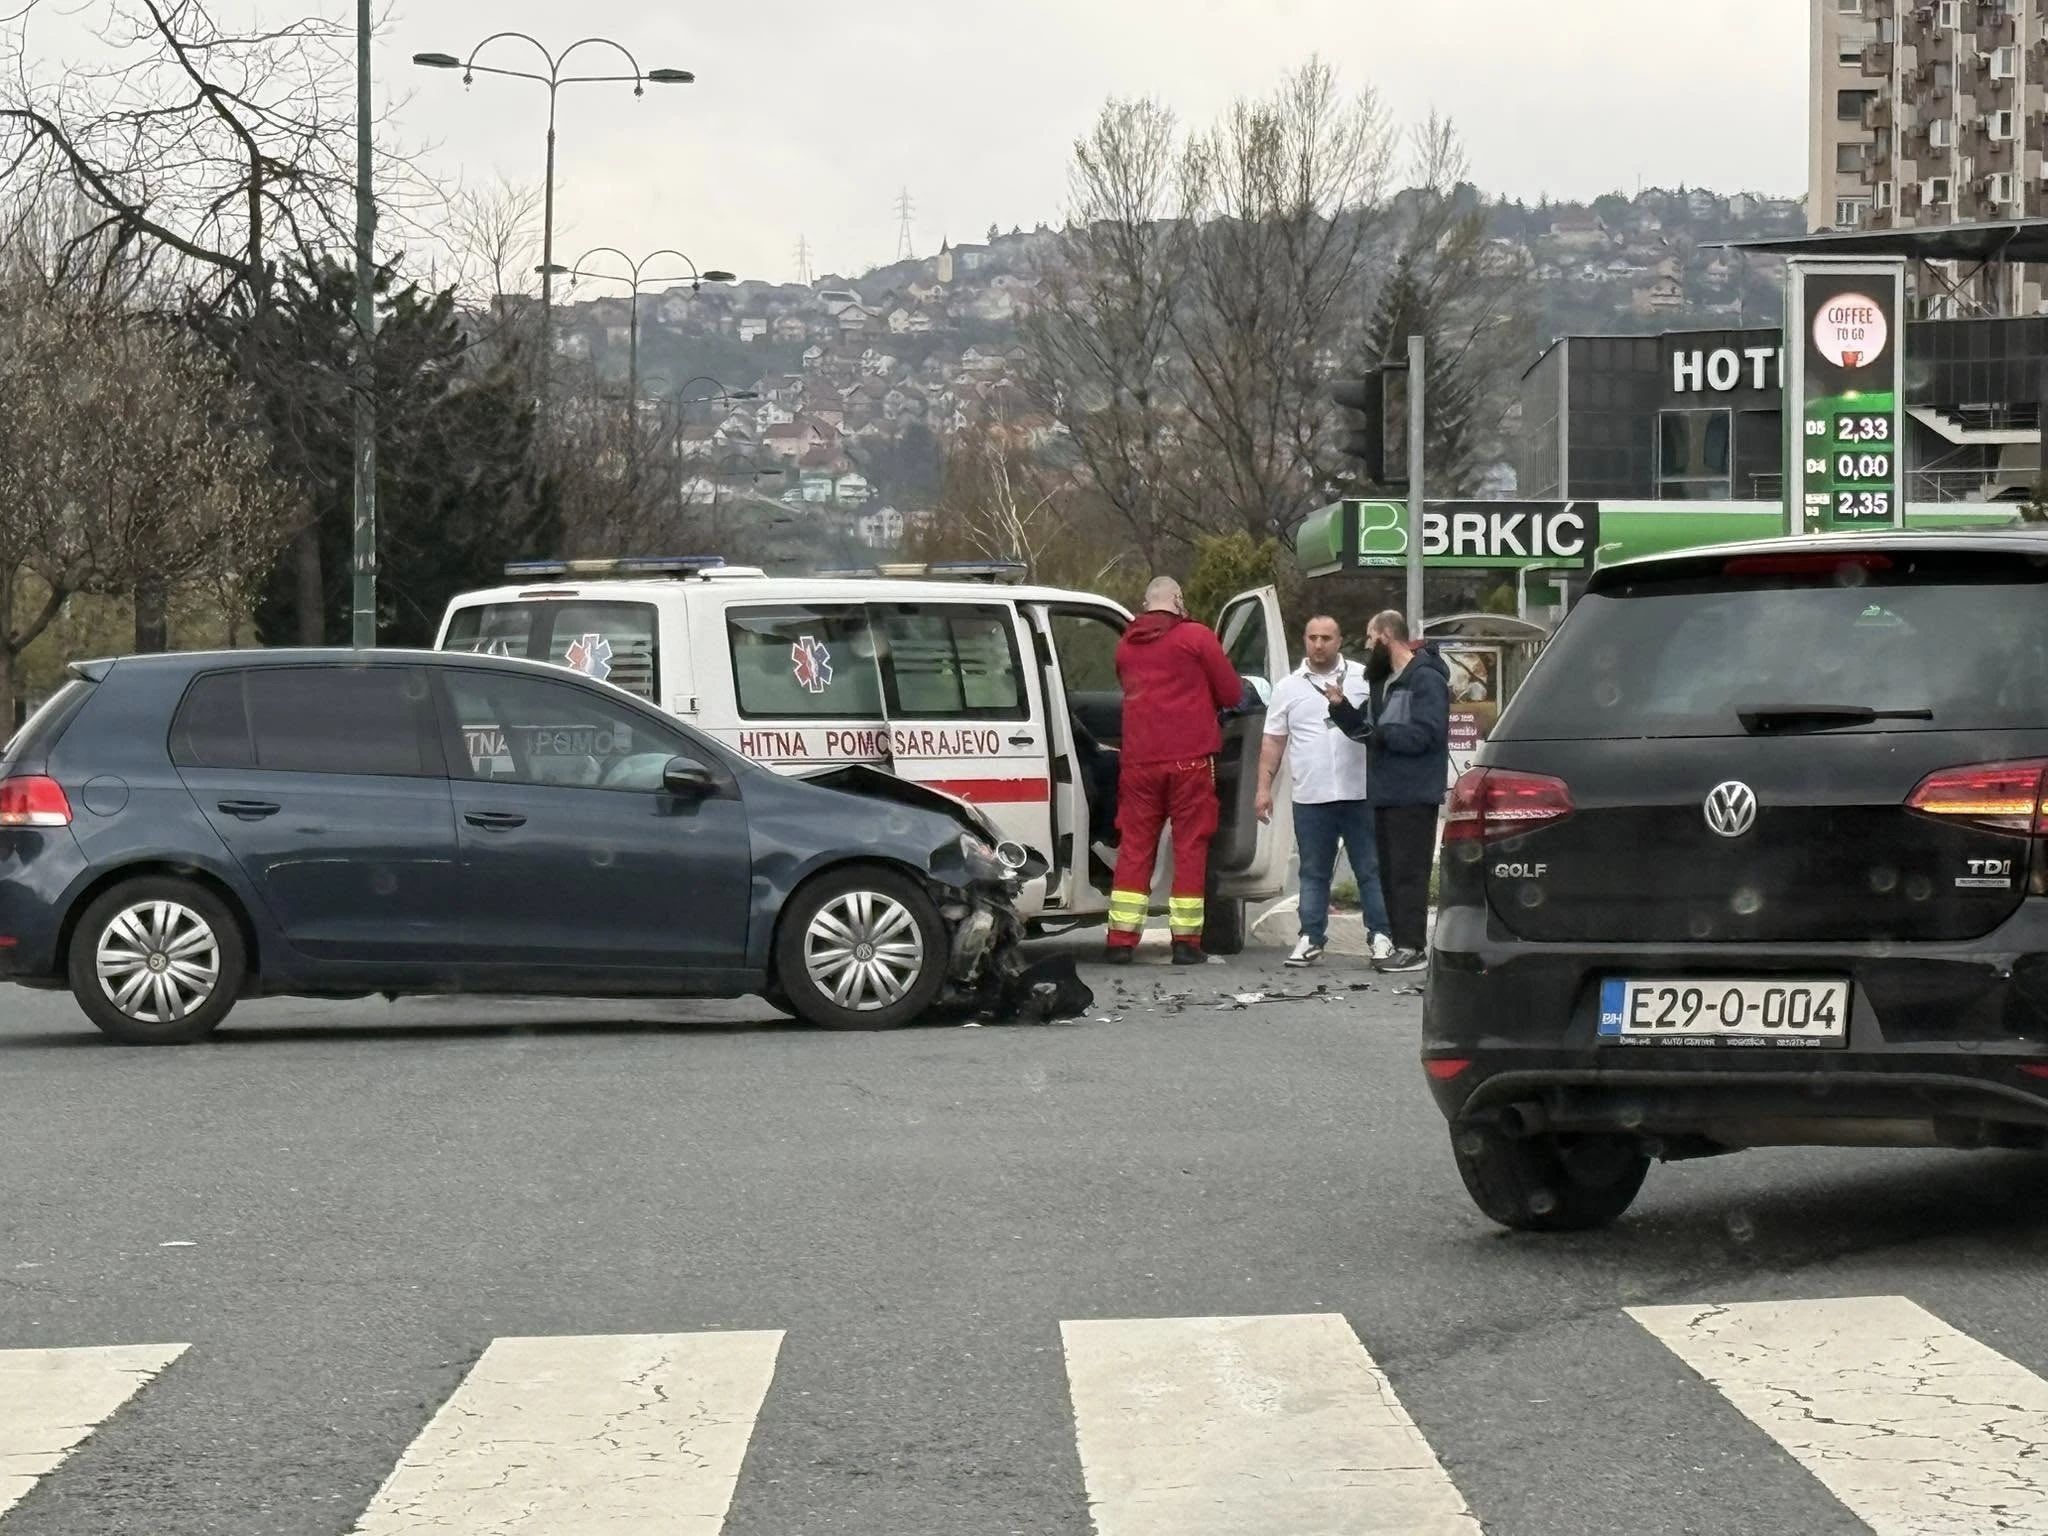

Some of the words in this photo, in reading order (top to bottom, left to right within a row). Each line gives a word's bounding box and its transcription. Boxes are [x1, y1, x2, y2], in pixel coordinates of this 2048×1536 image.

[1828, 307, 1873, 325] COFFEE
[1837, 327, 1849, 341] TO
[1851, 327, 1865, 341] GO
[1838, 417, 1888, 444] 2,33
[1838, 454, 1888, 481] 0,00
[1838, 492, 1888, 518] 2,35
[1422, 501, 1585, 557] BRKIĆ
[739, 731, 809, 757] HITNA
[895, 729, 1000, 756] SARAJEVO
[1494, 863, 1547, 878] GOLF
[1967, 860, 2011, 875] TDI
[1629, 987, 1837, 1030] E29-O-004
